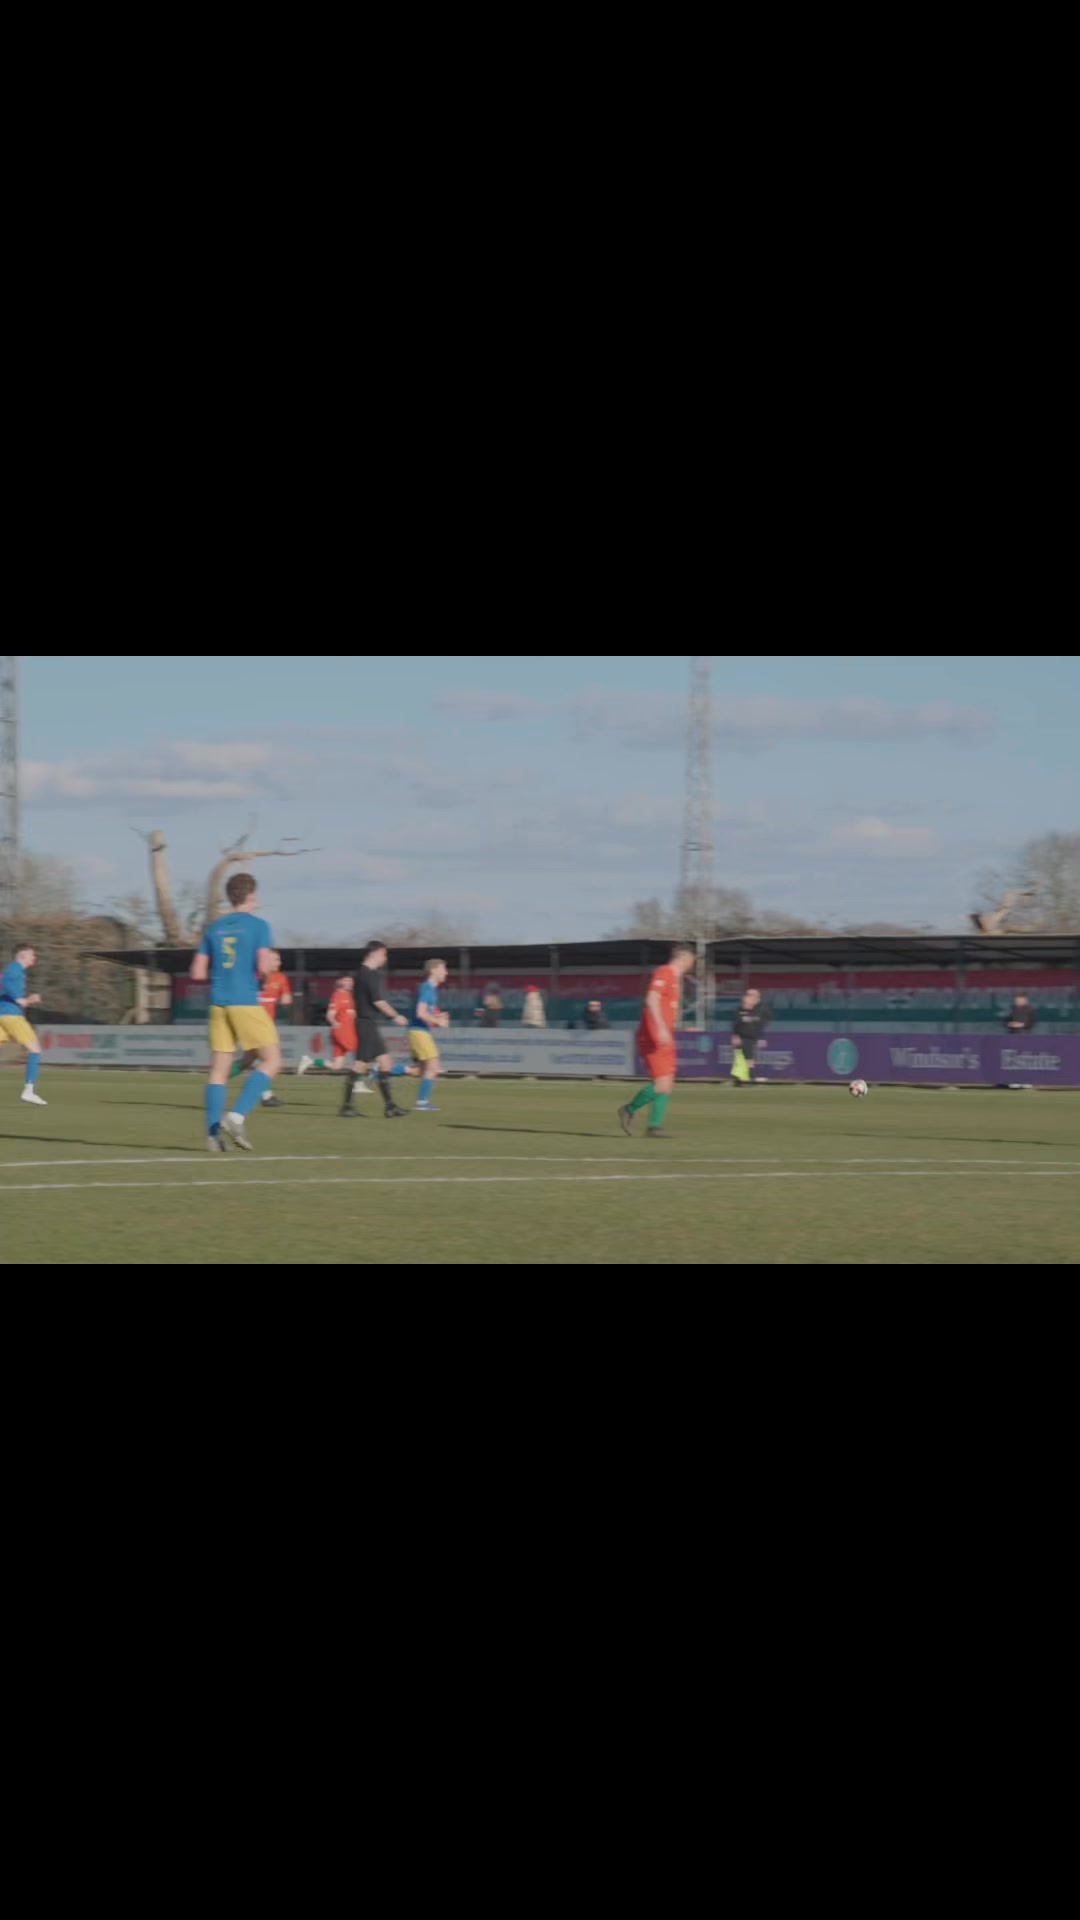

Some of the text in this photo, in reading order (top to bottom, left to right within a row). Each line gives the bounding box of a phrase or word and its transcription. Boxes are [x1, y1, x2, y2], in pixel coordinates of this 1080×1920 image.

[222, 937, 237, 969] 5
[889, 1046, 1061, 1071] Windsor's Estate
